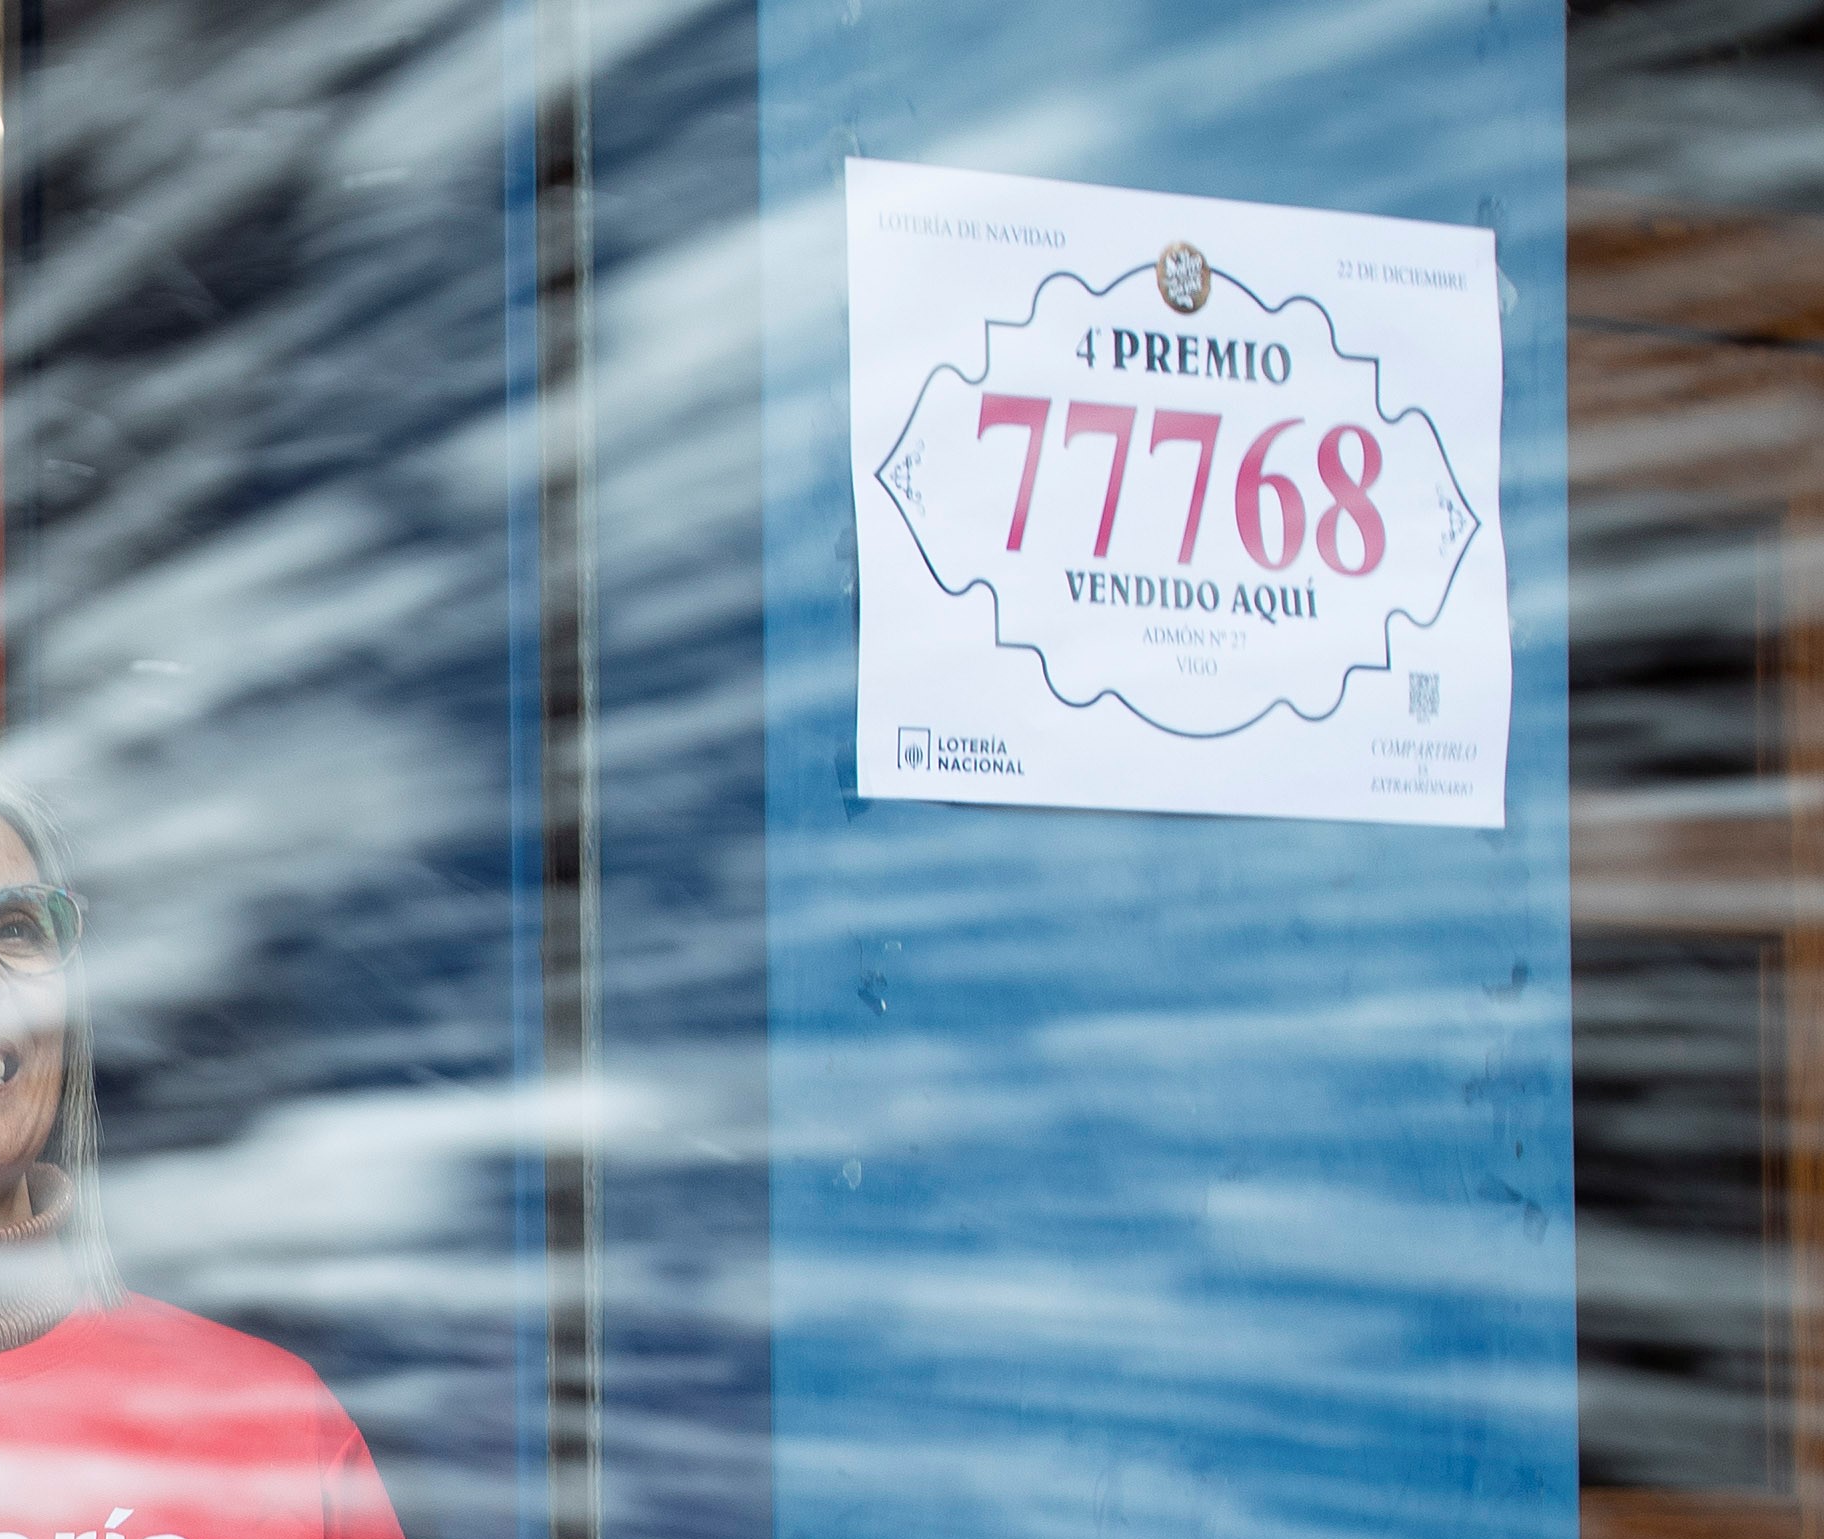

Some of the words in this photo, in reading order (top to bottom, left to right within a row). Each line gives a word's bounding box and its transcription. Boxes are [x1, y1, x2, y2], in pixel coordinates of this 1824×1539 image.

[877, 210, 953, 238] LOTERÍA
[957, 217, 981, 240] DE
[985, 222, 1066, 248] NAVIDAD
[1337, 259, 1353, 279] 22
[1356, 261, 1378, 283] DE
[1382, 264, 1469, 291] DICIEMBRE
[1112, 327, 1292, 386] PREMIO
[977, 392, 1387, 578] 77768
[1065, 569, 1220, 613] VENDIDO
[1232, 576, 1318, 625] AQUÍ
[1142, 624, 1204, 647] ADMÓN
[1176, 655, 1218, 676] VIGO
[938, 733, 1007, 755] LOTERÍA
[938, 757, 1024, 775] NACIONAL
